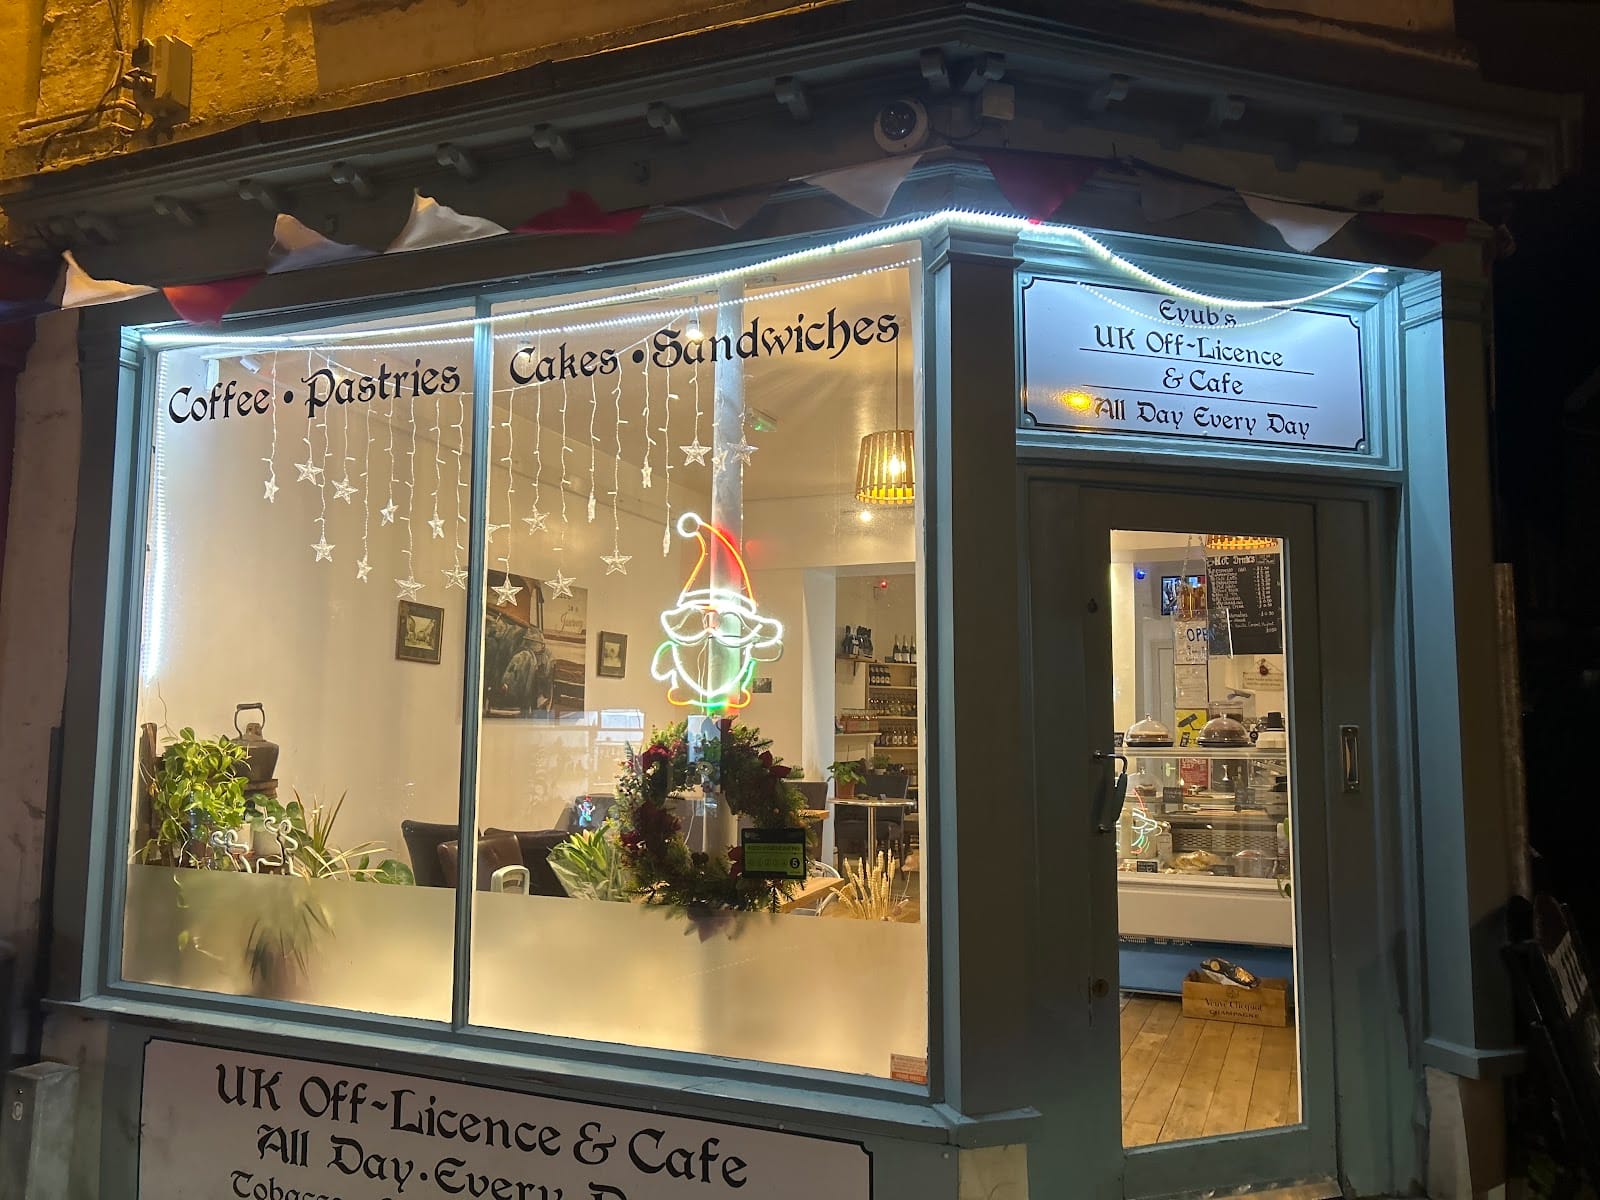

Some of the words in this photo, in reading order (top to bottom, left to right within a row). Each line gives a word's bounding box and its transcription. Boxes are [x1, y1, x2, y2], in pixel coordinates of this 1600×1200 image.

[1158, 299, 1236, 327] Eyub's
[168, 380, 270, 424] Coffee
[301, 358, 461, 419] Pastries
[509, 342, 618, 385] Cakes
[652, 306, 900, 368] Sandwiches
[1094, 324, 1136, 351] UK
[1145, 330, 1284, 367] Off-Licence
[1162, 367, 1184, 389] &
[1189, 369, 1244, 395] Cafe
[1093, 397, 1126, 421] All
[1136, 401, 1184, 430] Day
[1193, 407, 1257, 436] Every
[1266, 413, 1310, 440] Day
[1186, 627, 1216, 642] OPEN
[215, 1063, 283, 1111] UK
[299, 1076, 561, 1156] Off-Licence
[573, 1121, 617, 1165] &
[628, 1128, 748, 1188] Cafe
[256, 1123, 311, 1168] All
[326, 1134, 414, 1194] Day
[434, 1157, 563, 1200] Every
[230, 1170, 344, 1200] Toba
